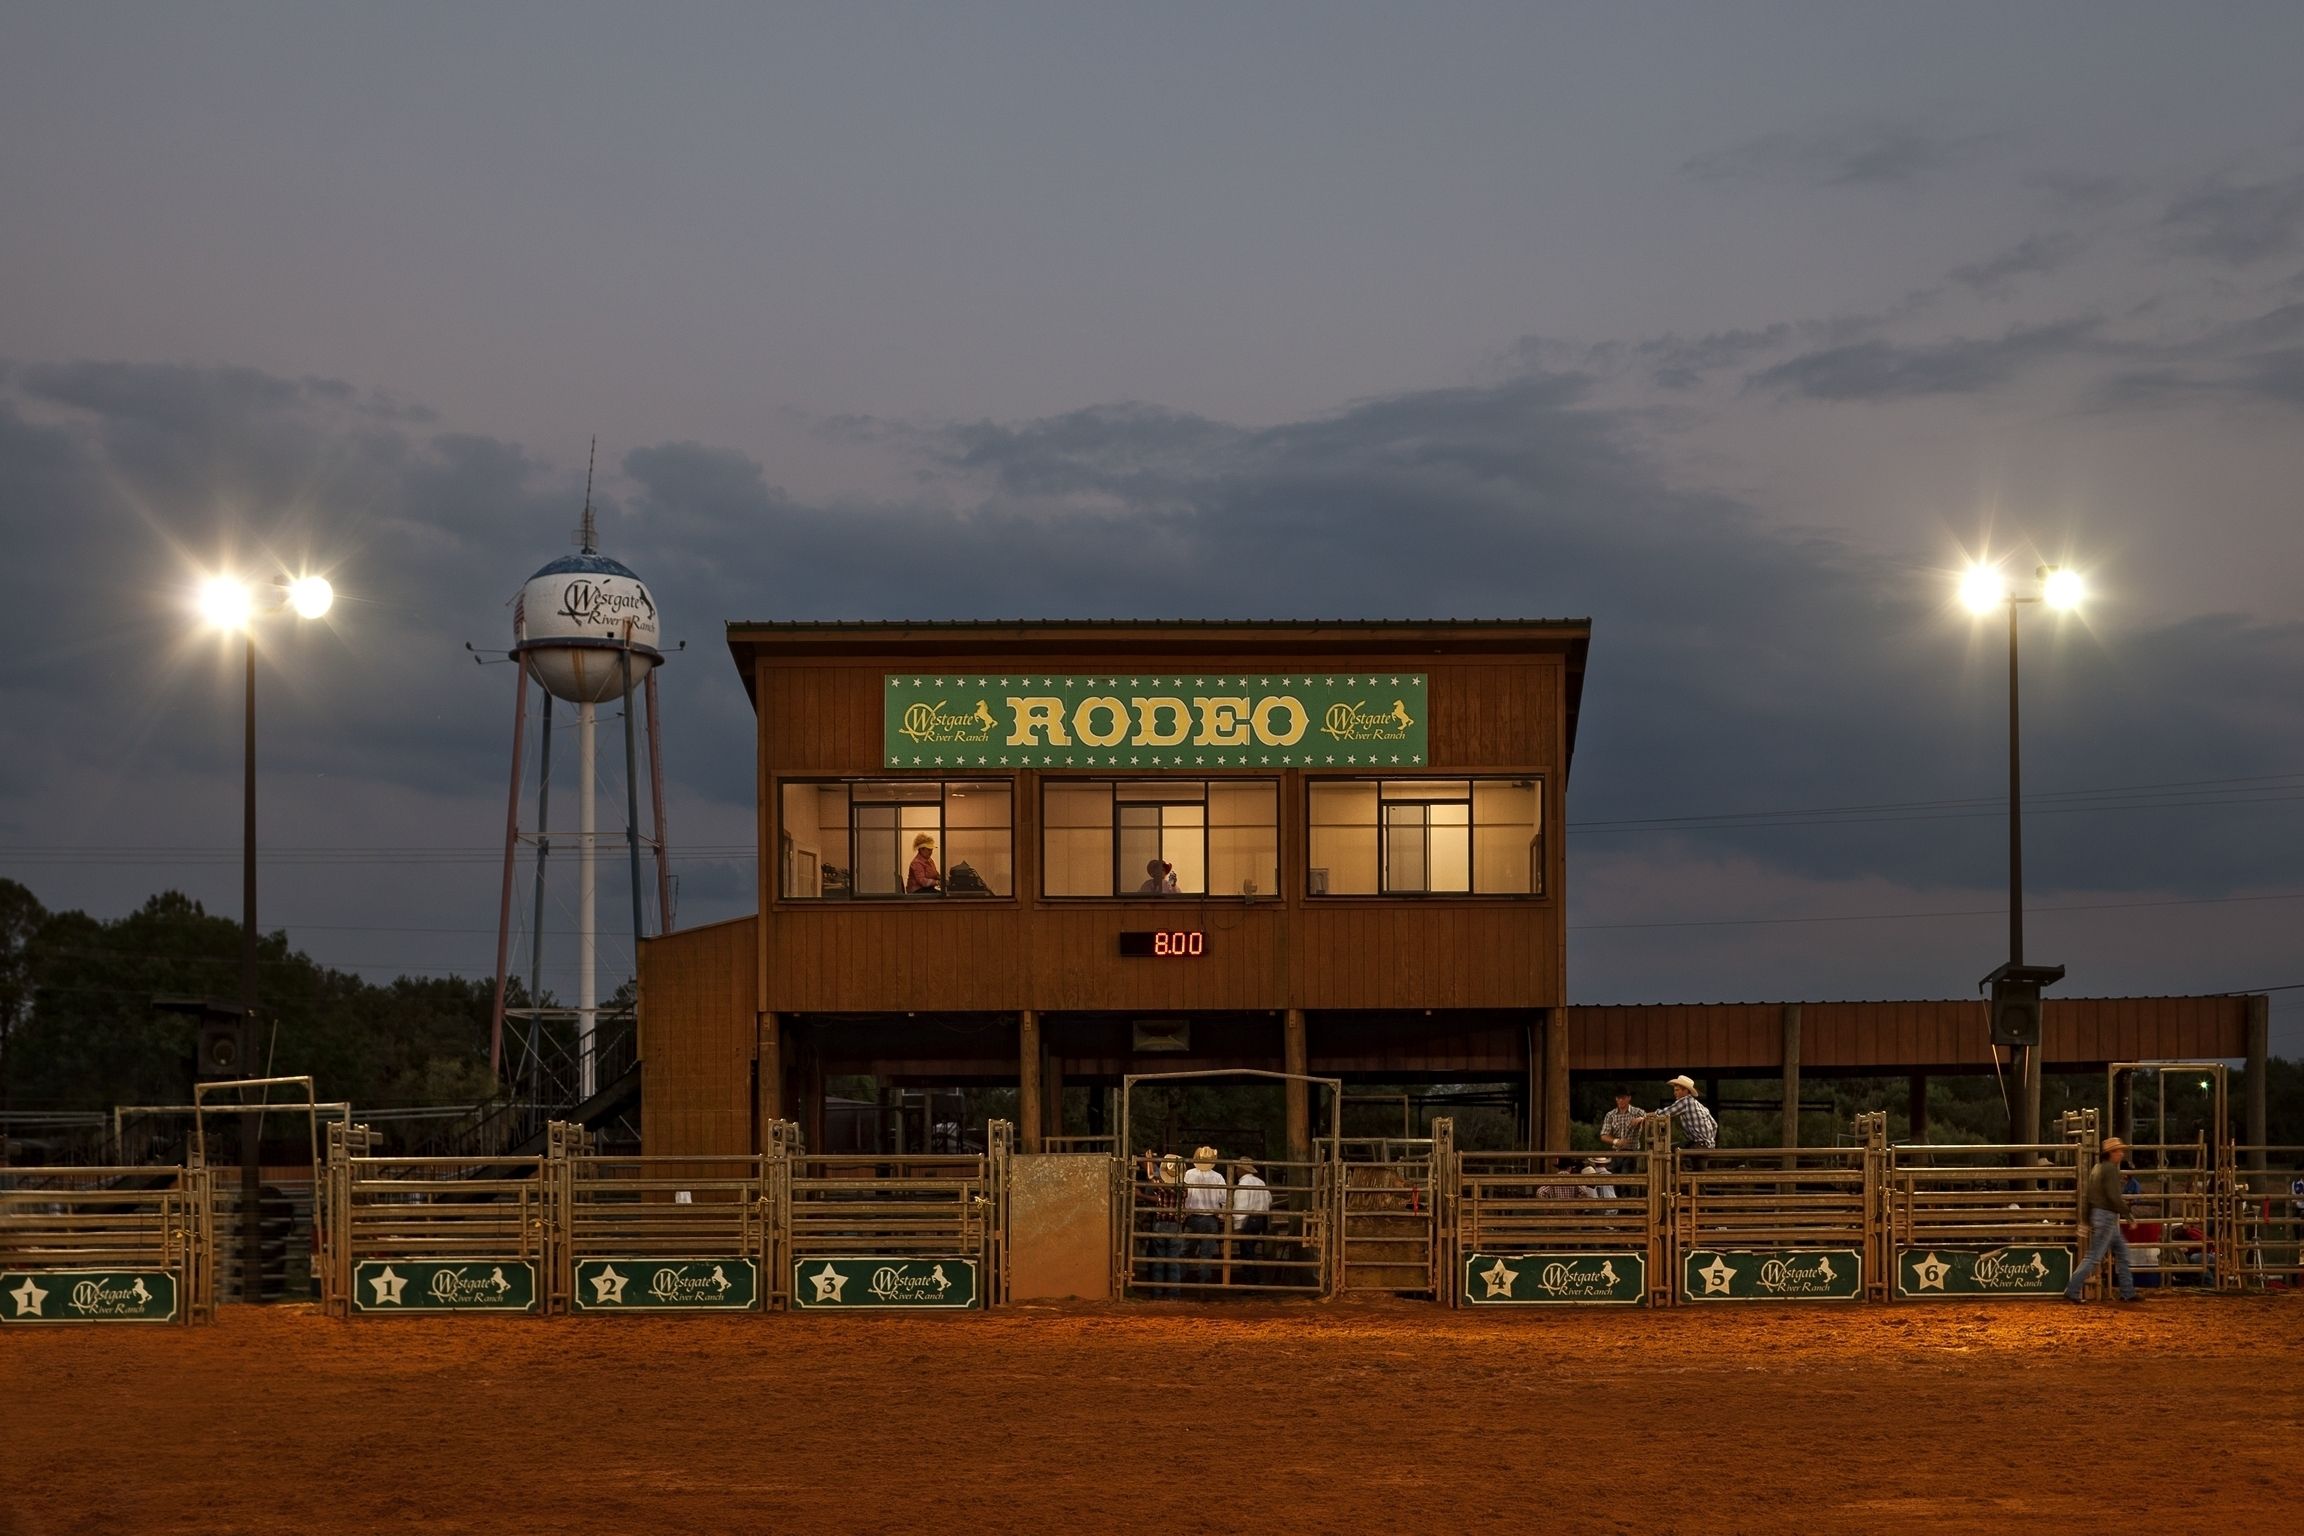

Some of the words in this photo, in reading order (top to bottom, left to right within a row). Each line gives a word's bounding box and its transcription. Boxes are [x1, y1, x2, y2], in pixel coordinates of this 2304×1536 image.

[573, 582, 640, 613] Westgate
[587, 611, 623, 626] River
[630, 615, 655, 633] Ranch
[911, 706, 973, 732] Westgate
[1006, 696, 1310, 747] RODEO
[1332, 706, 1391, 730] Westgate
[923, 730, 953, 742] River
[954, 730, 989, 742] Ranch
[1343, 729, 1372, 740] River
[1372, 728, 1406, 740] Ranch
[1155, 932, 1202, 955] 8.00
[1547, 1264, 1601, 1287] Westgate
[1765, 1261, 1818, 1283] Westgate
[1924, 1264, 1939, 1282] 6
[1978, 1257, 2030, 1278] Westgate
[436, 1272, 491, 1293] Westgate
[602, 1278, 617, 1295] 2
[657, 1270, 711, 1292] Westgate
[822, 1276, 836, 1294] 3
[877, 1269, 932, 1291] Westgate
[1491, 1271, 1507, 1289] 4
[1711, 1269, 1726, 1287] 5
[1776, 1282, 1801, 1292] River
[1801, 1281, 1830, 1292] Ranch
[1990, 1277, 2013, 1287] River
[2014, 1277, 2043, 1287] Ranch
[77, 1283, 131, 1305] Westgate
[382, 1279, 395, 1297] 1
[668, 1291, 693, 1302] River
[694, 1291, 724, 1301] Ranch
[888, 1290, 914, 1300] River
[914, 1290, 944, 1300] Ranch
[1558, 1285, 1582, 1296] River
[1583, 1285, 1613, 1296] Ranch
[23, 1290, 36, 1308] 1
[448, 1292, 472, 1303] River
[473, 1292, 504, 1303] Ranch
[89, 1303, 113, 1314] River
[114, 1303, 146, 1314] Ranch
